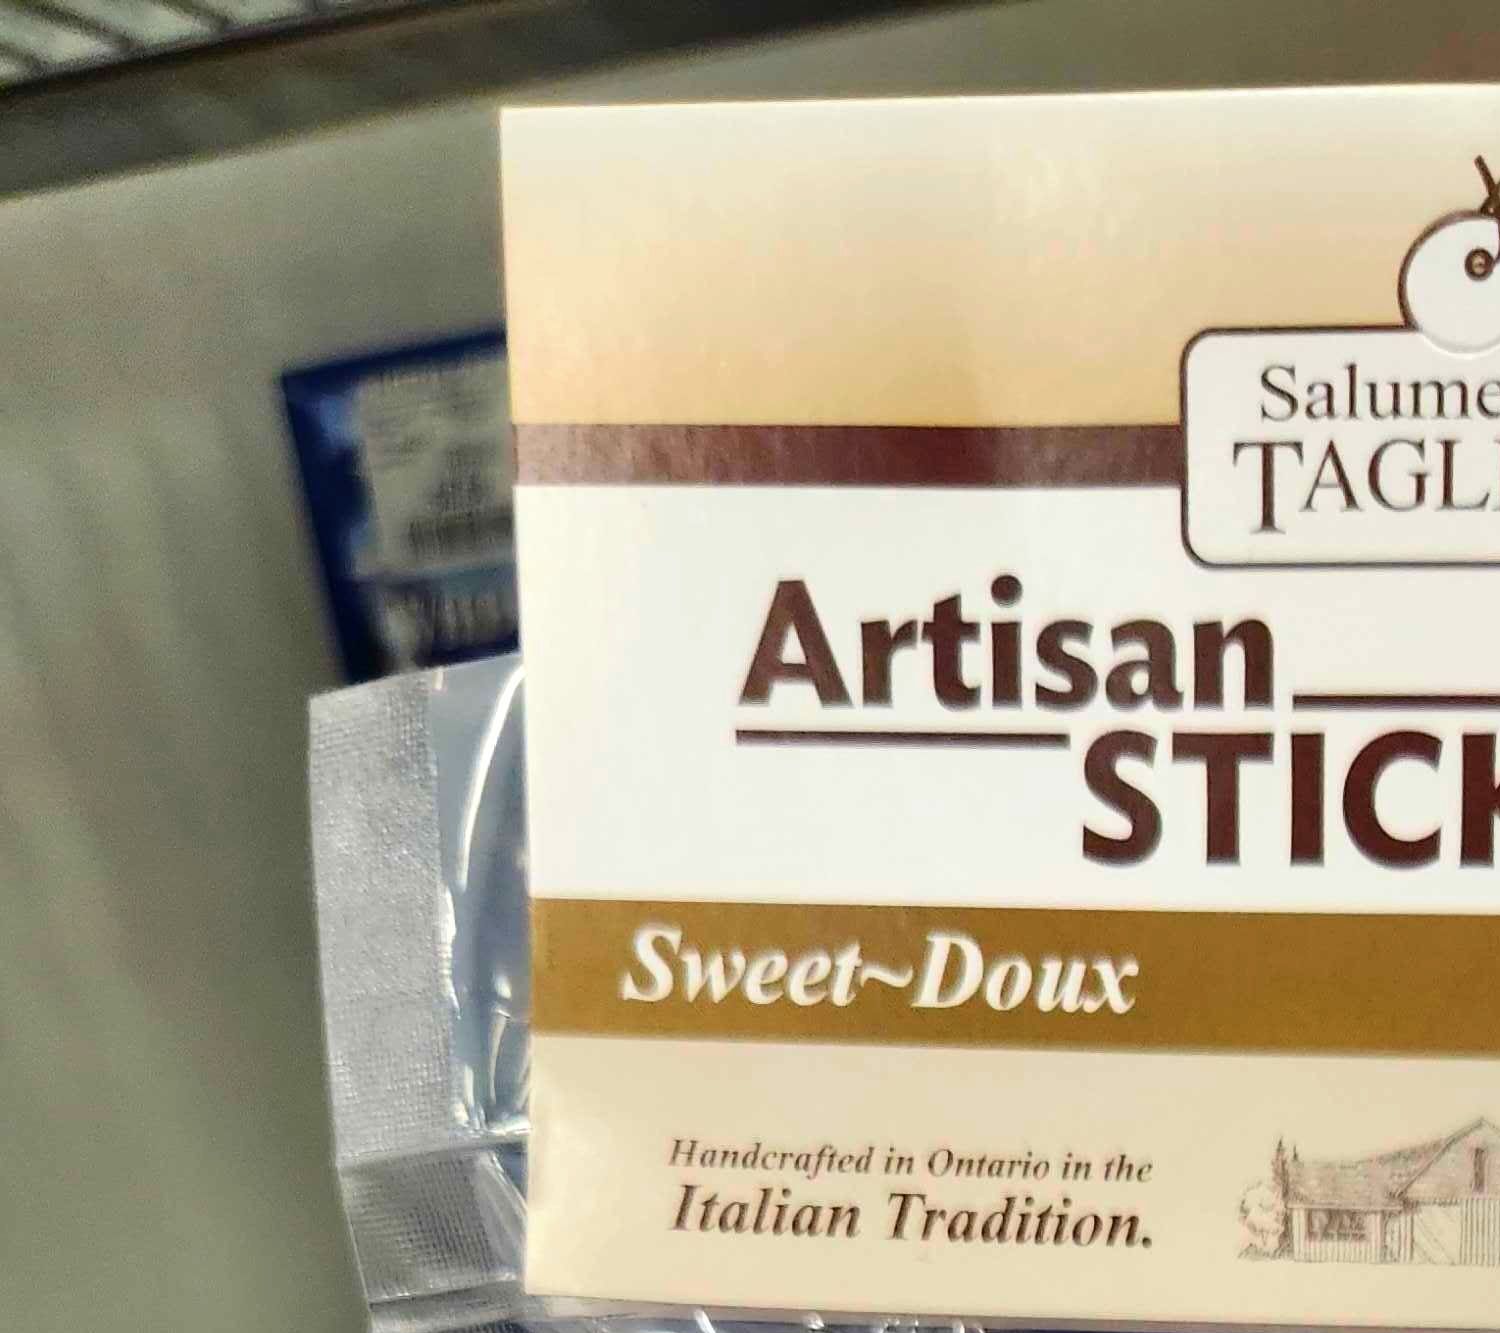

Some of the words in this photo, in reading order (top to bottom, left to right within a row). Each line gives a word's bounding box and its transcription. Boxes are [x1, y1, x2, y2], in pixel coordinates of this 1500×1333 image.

[738, 572, 1276, 713] Artisan
[668, 1137, 876, 1181] Handcrafted
[882, 1145, 916, 1176] in
[926, 1147, 1051, 1180] Ontario
[1060, 1150, 1093, 1182] in
[1103, 1152, 1154, 1184] the
[672, 1182, 861, 1240] Italian
[887, 1191, 1153, 1250] Tradition.
